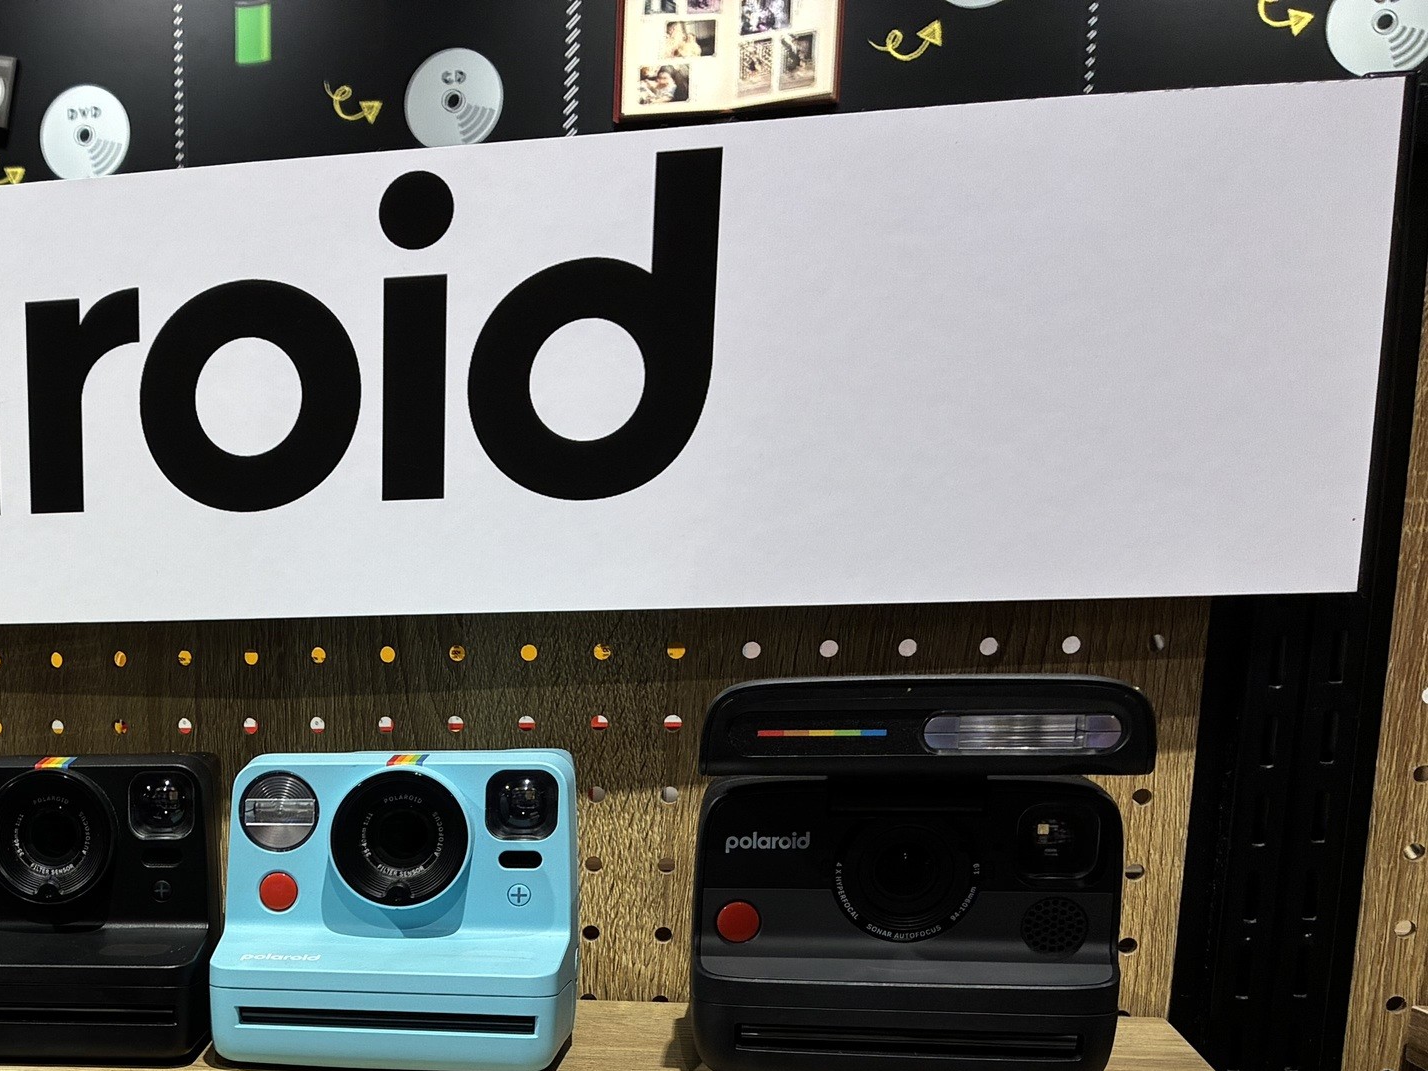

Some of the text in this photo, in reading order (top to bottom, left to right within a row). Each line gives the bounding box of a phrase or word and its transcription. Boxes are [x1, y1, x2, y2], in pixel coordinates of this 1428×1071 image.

[441, 69, 466, 84] CD
[67, 106, 102, 121] DVD
[725, 831, 810, 853] polaroid
[835, 876, 859, 920] HYPERFOCAL
[866, 923, 942, 939] SONAR AUTOFOCUS
[240, 953, 322, 962] polaroid
